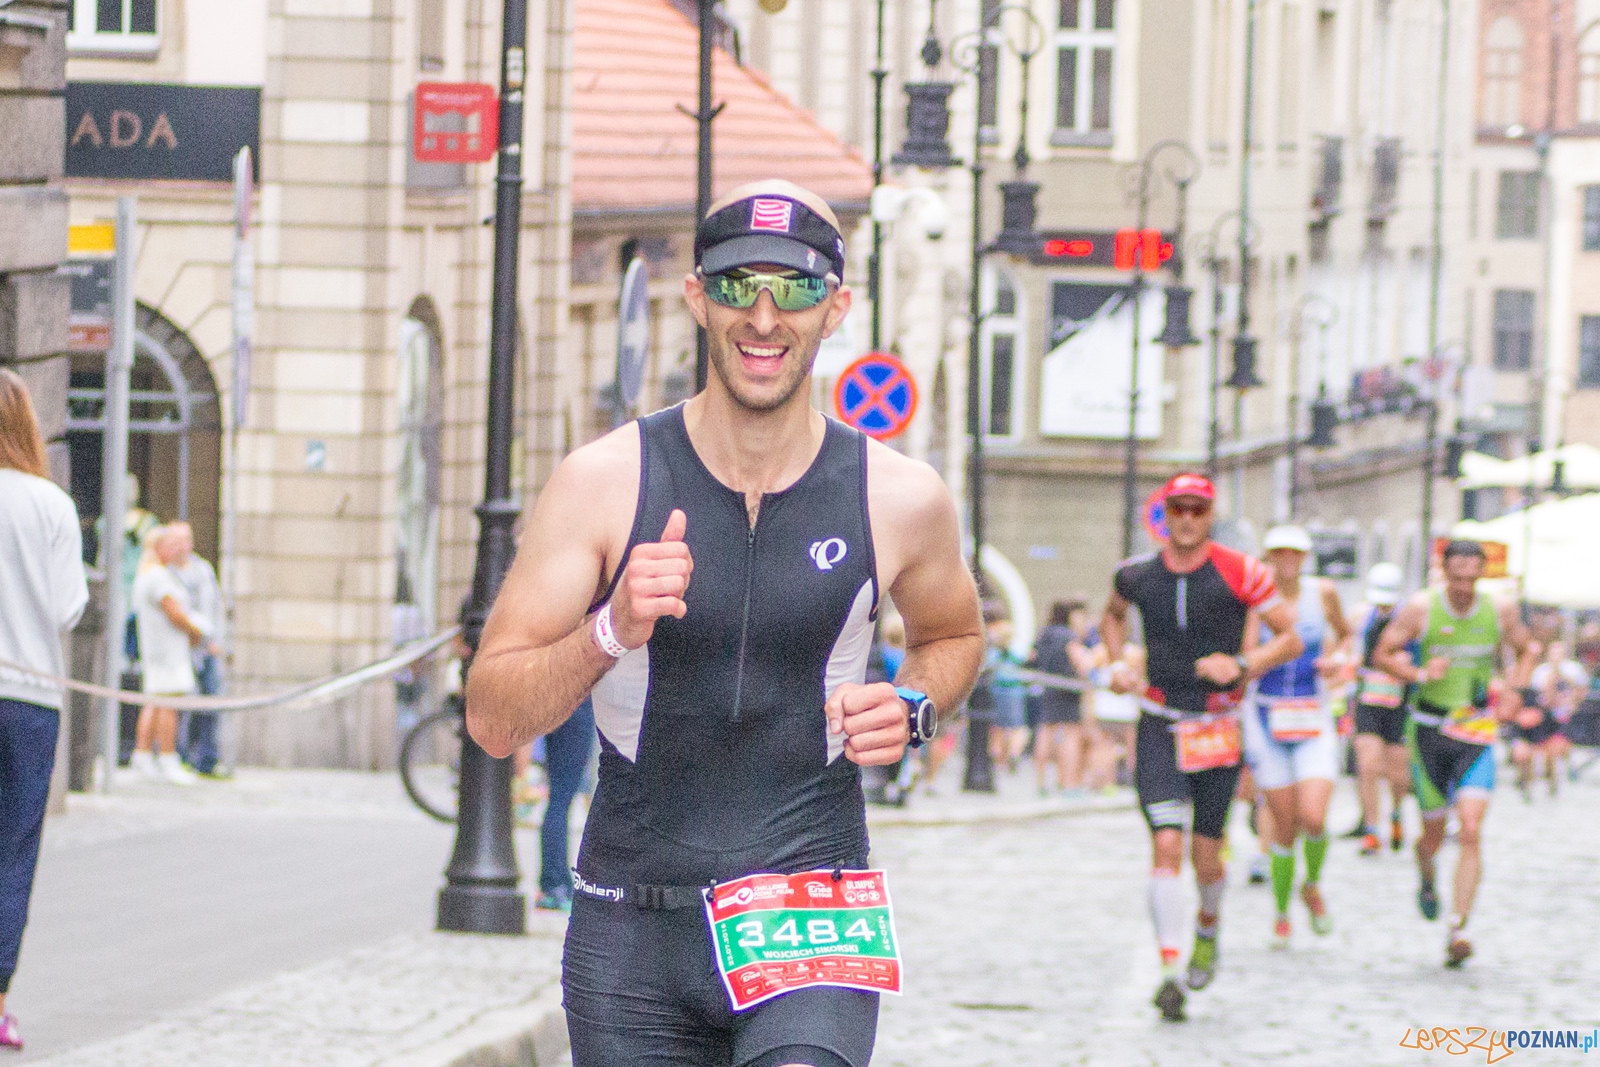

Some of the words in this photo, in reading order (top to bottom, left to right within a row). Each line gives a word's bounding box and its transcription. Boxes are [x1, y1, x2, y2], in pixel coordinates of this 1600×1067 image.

[580, 879, 624, 902] Kalenji
[807, 885, 833, 894] Enea
[846, 880, 876, 889] OLIMPIC
[735, 918, 876, 947] 3484
[763, 947, 814, 959] WOJCIECH
[814, 944, 859, 955] SIKORSKI
